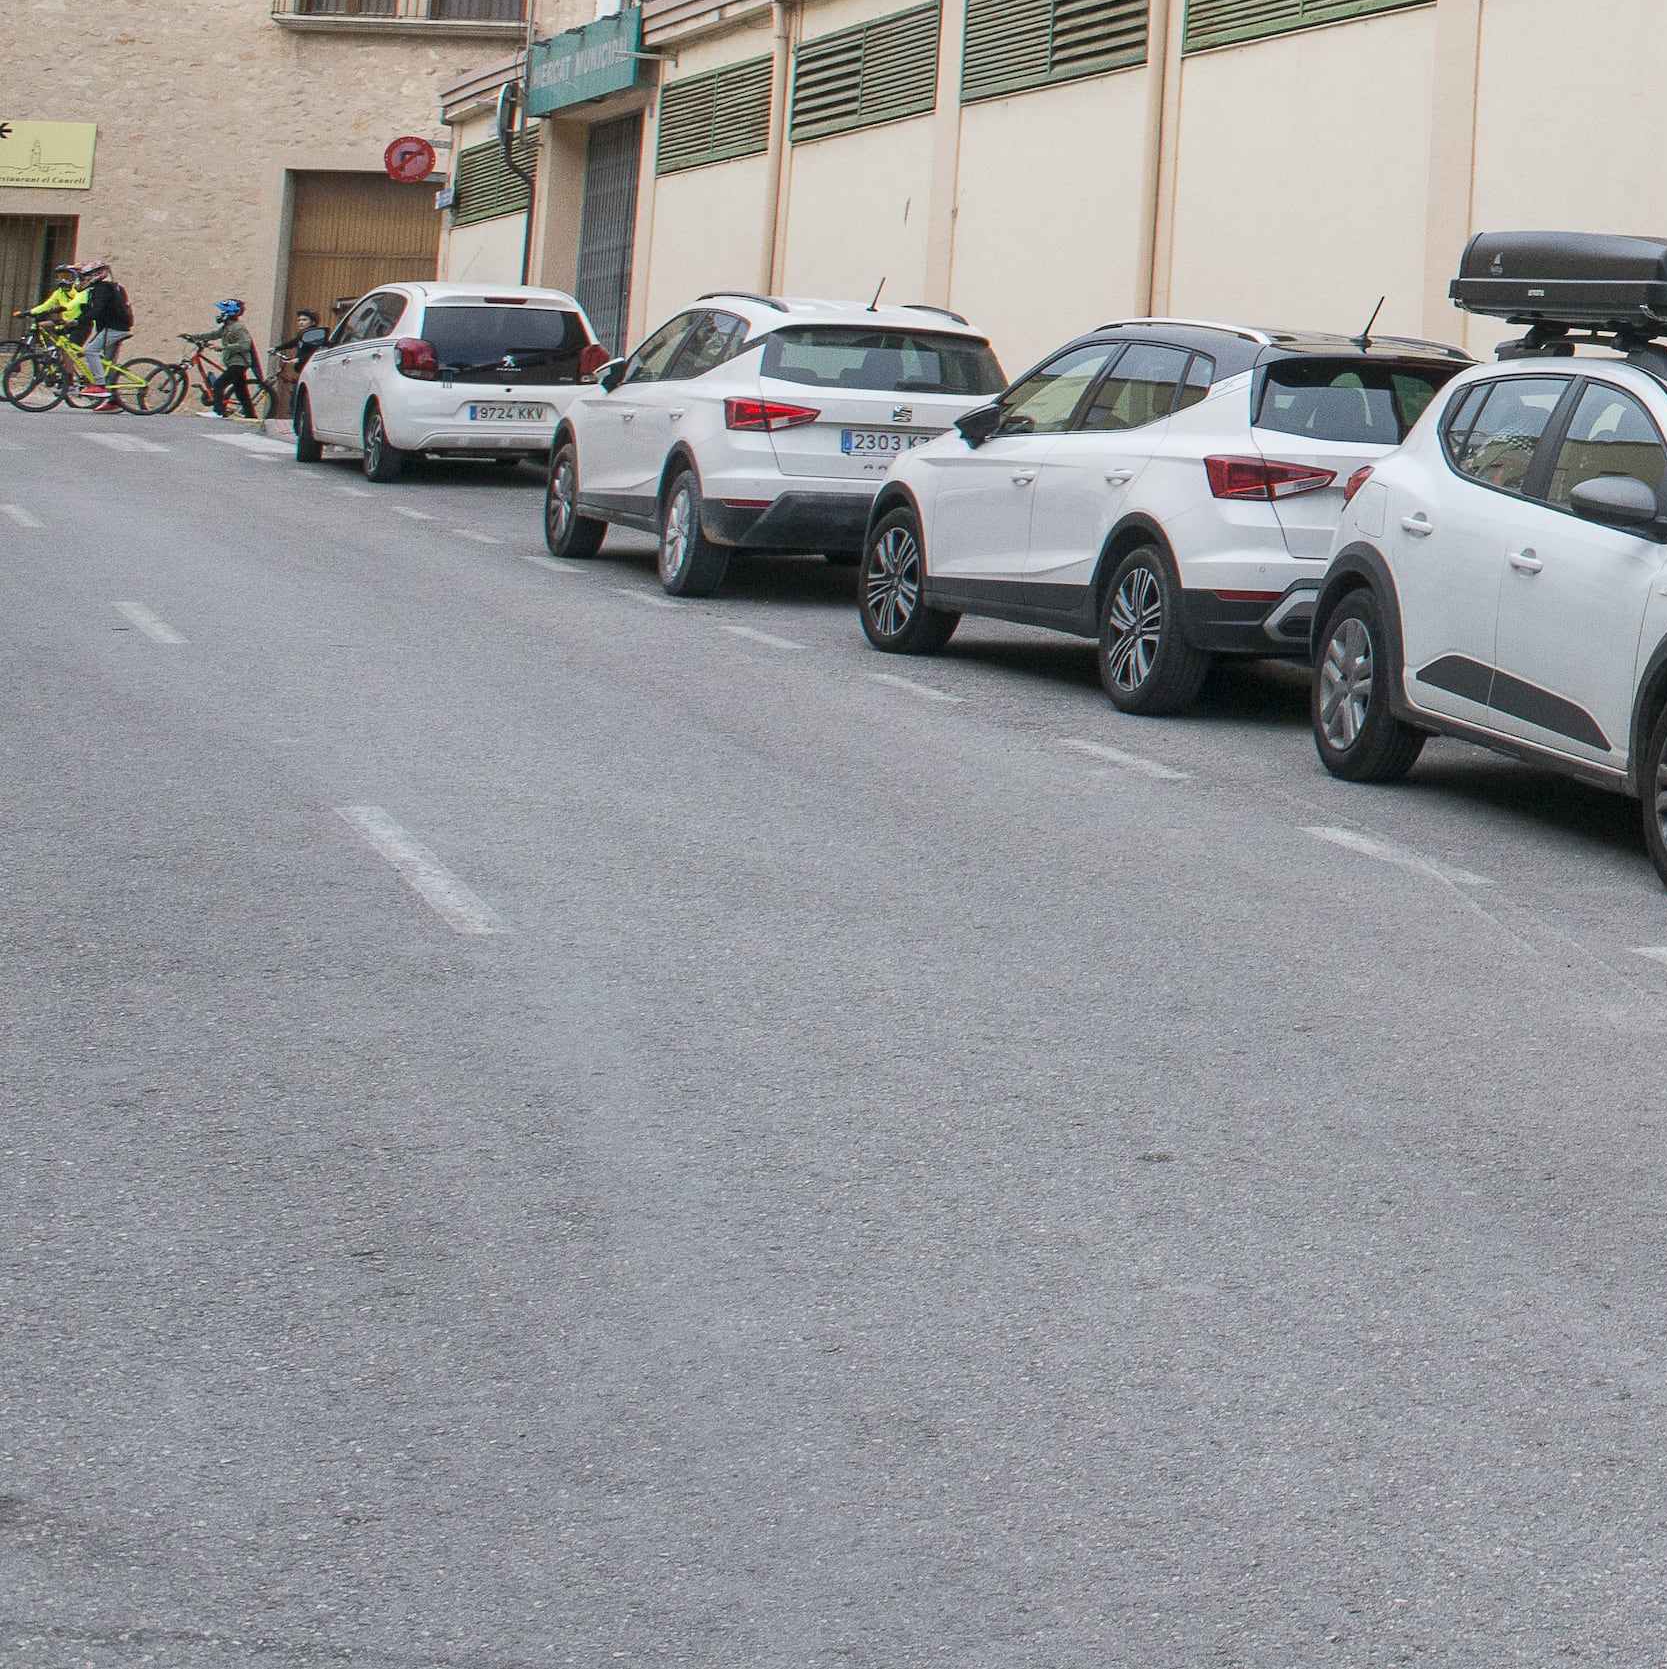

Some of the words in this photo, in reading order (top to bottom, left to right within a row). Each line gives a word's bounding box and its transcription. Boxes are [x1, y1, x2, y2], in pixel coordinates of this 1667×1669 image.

[480, 407, 514, 419] 9724
[518, 407, 544, 420] KKV
[854, 433, 901, 451] 2303
